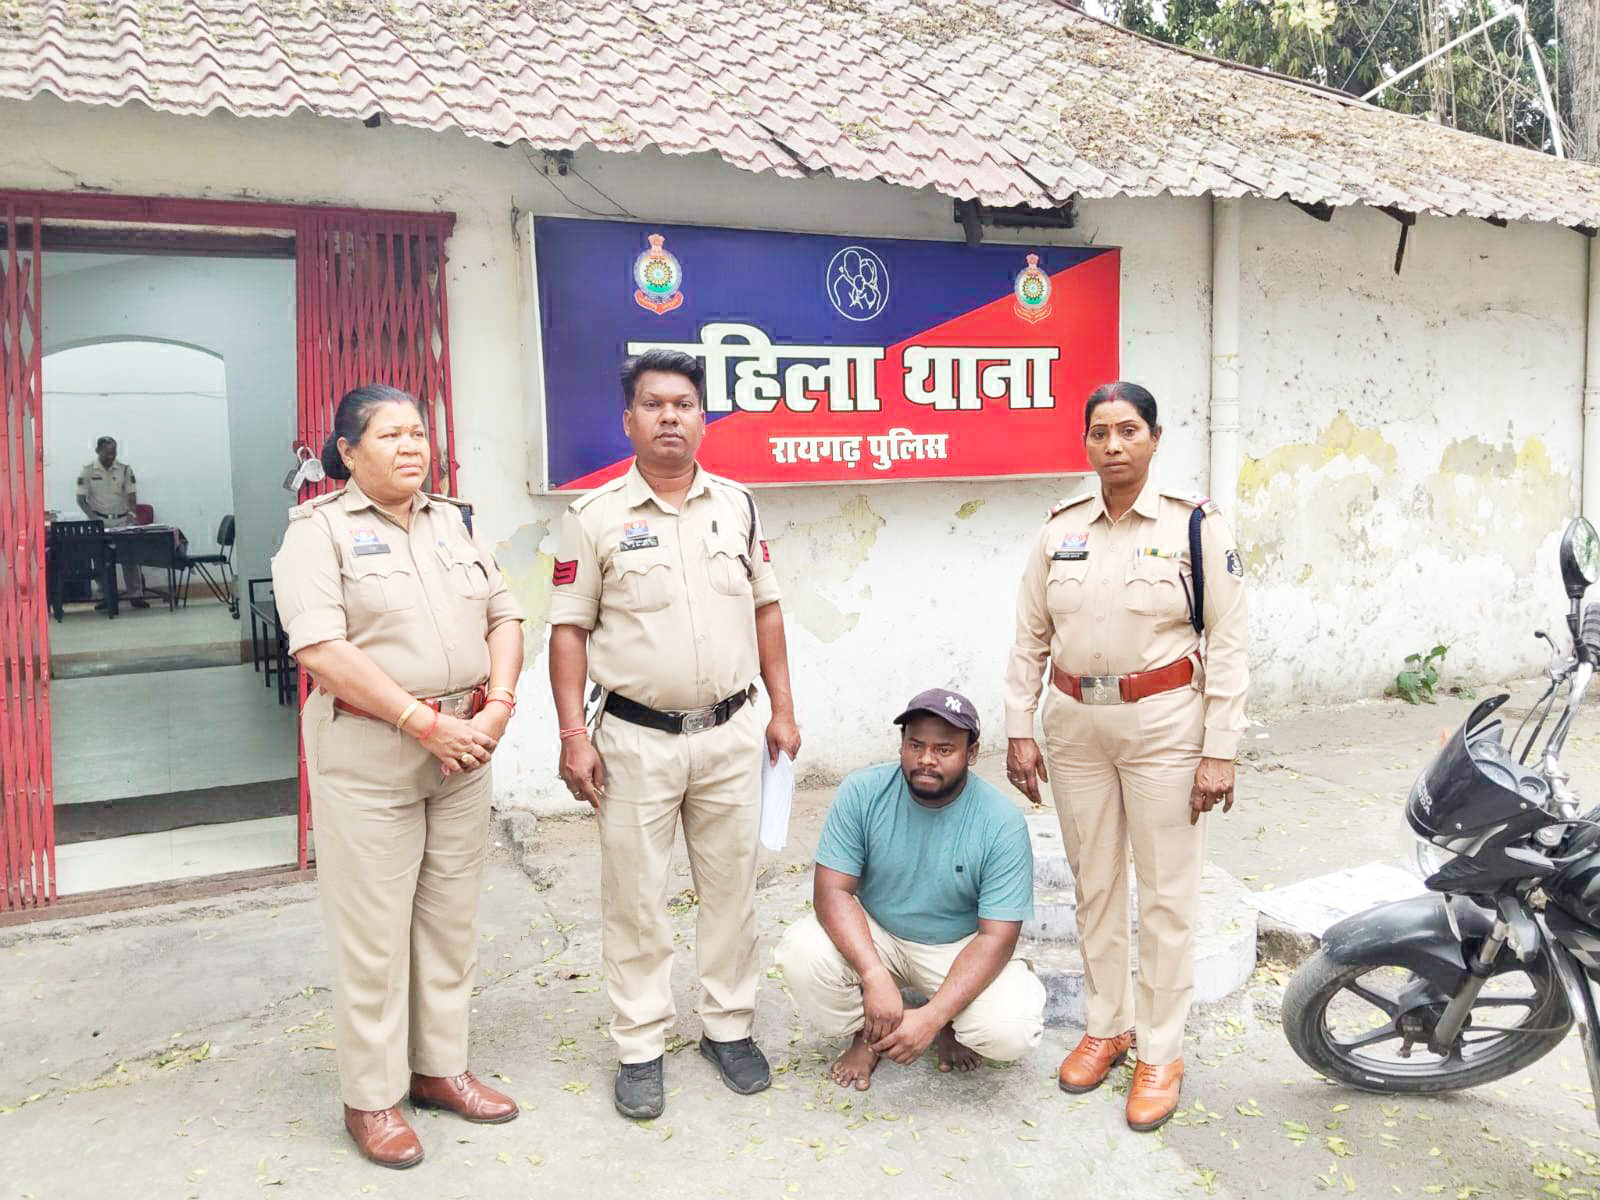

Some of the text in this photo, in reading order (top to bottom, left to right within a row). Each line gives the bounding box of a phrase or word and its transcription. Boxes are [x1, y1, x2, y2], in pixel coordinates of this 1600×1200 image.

[627, 322, 1061, 413] हिला थाना
[768, 427, 949, 470] रायगढ़ पुलिस
[944, 695, 963, 713] NY
